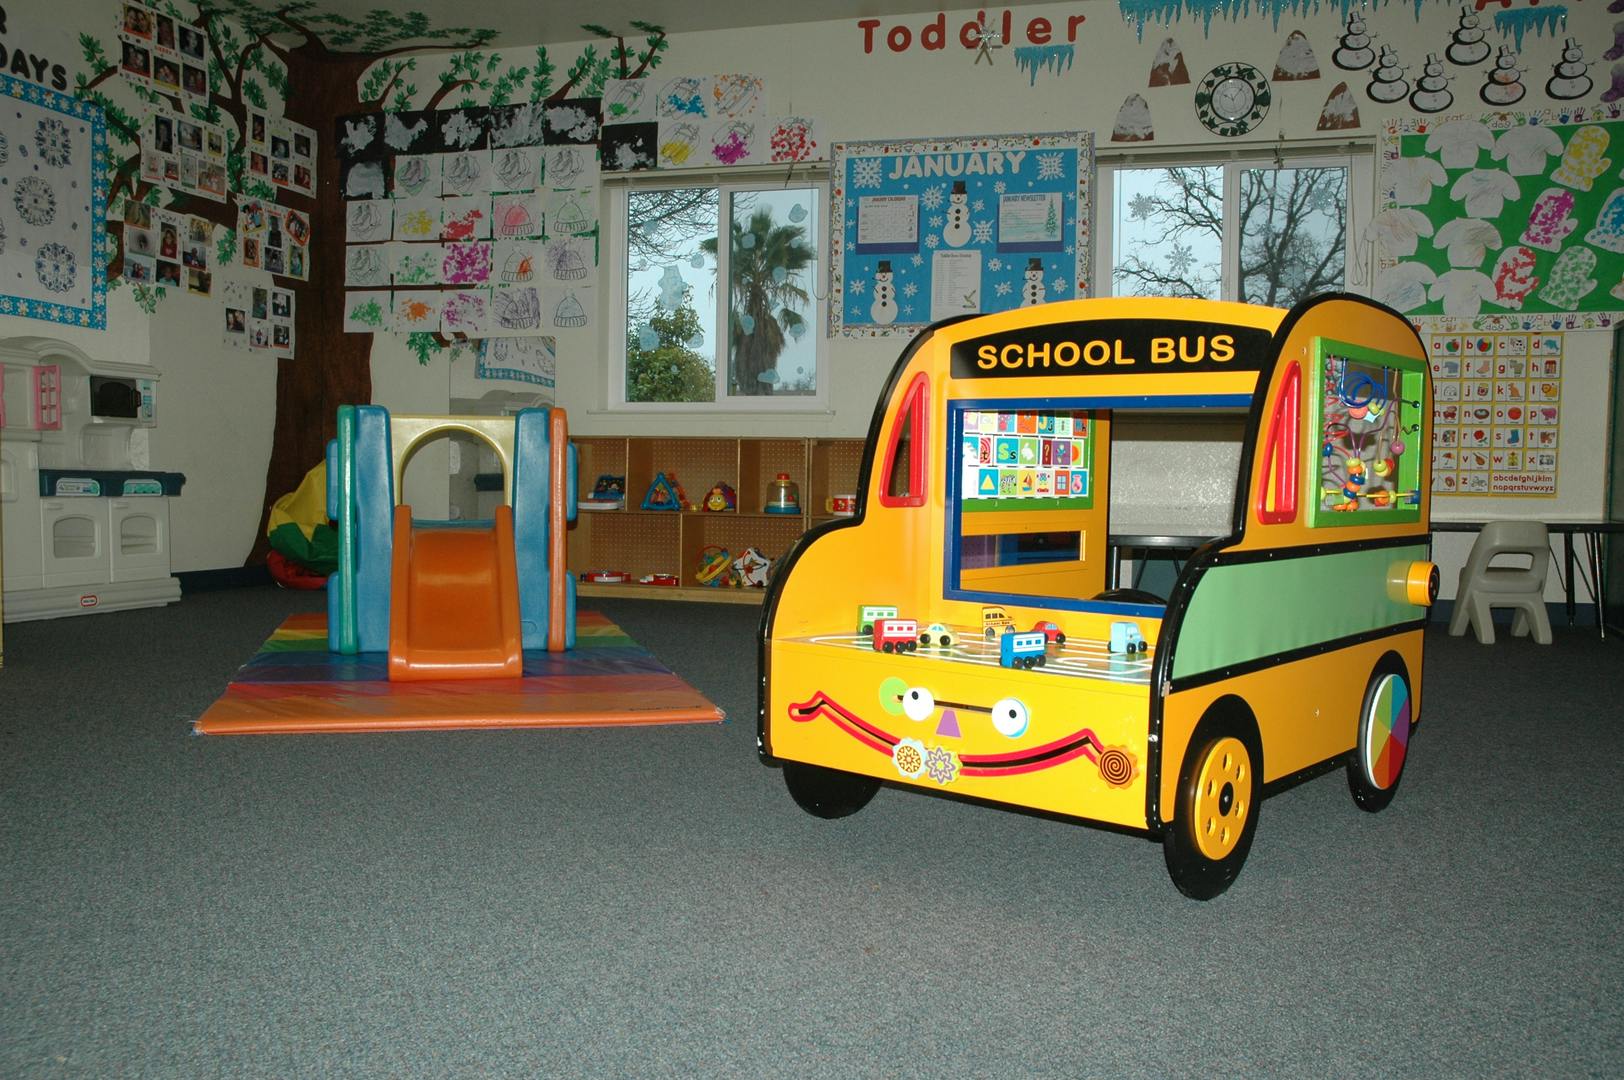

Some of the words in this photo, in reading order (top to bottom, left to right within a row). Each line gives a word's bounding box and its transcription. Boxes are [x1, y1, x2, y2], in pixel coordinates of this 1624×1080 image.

[858, 10, 1086, 54] Toddler
[888, 151, 1026, 180] JANUARY
[977, 339, 1136, 370] SCHOOL
[1150, 334, 1236, 364] BUS
[1493, 474, 1552, 484] abcdefghijklm
[1493, 483, 1554, 493] nopqrstuvwxyz
